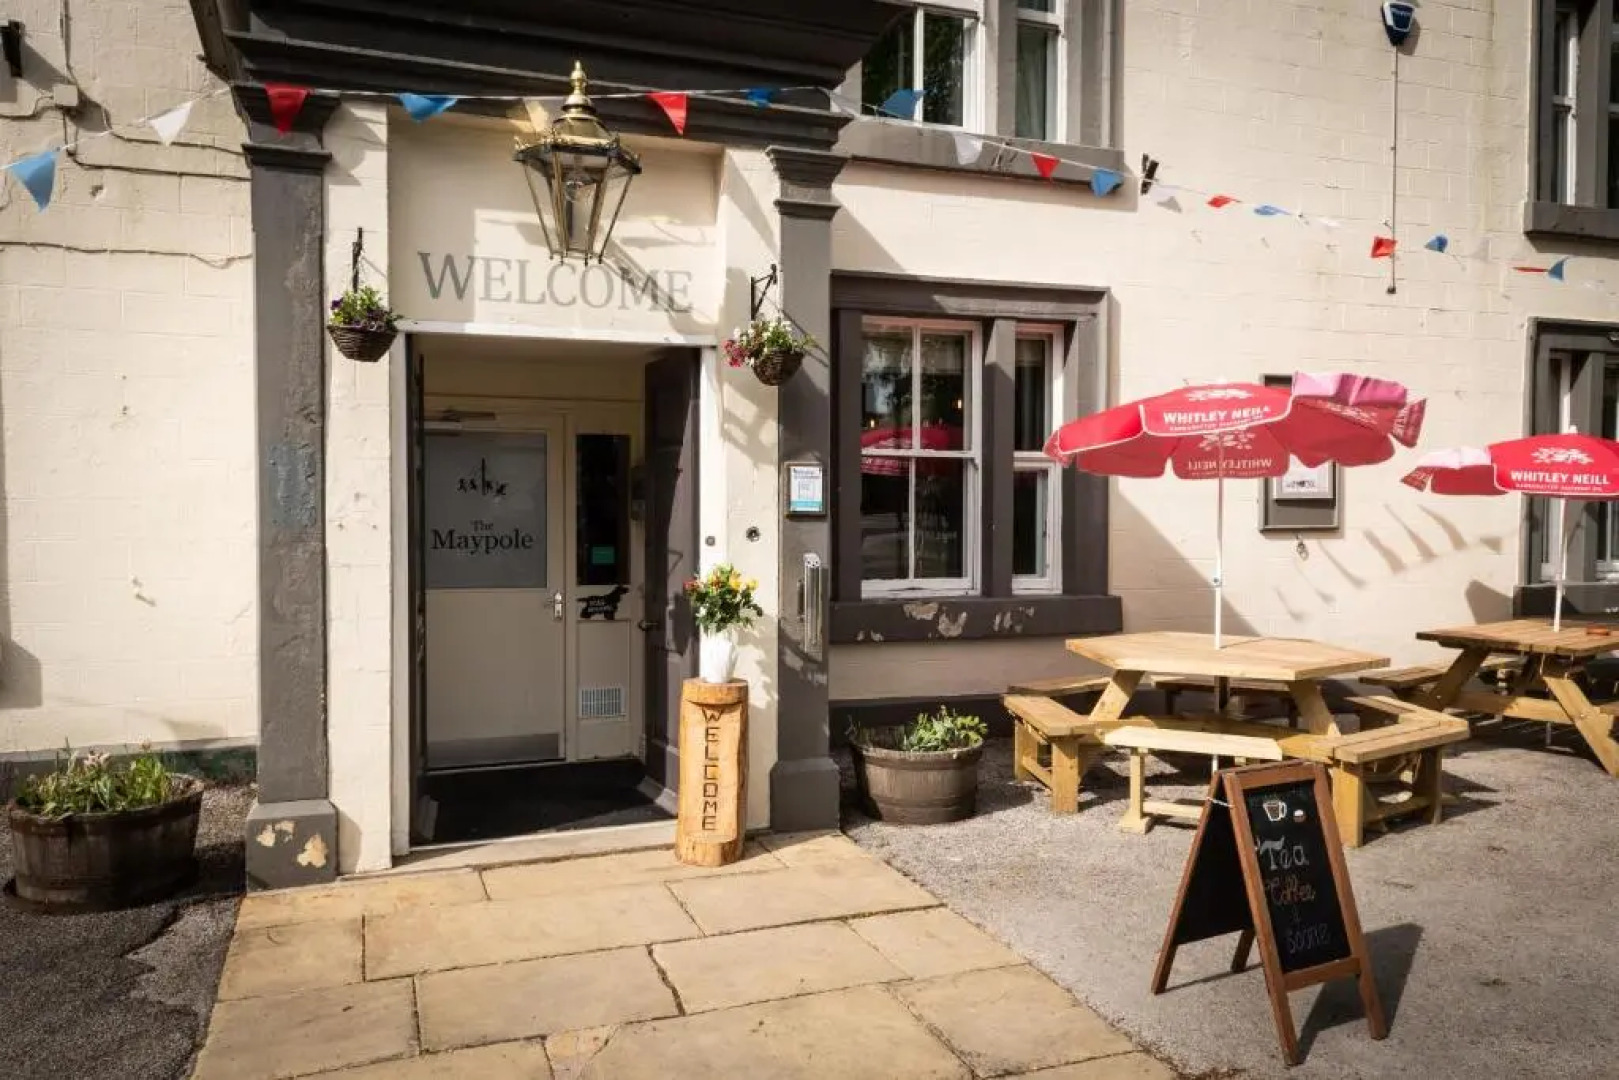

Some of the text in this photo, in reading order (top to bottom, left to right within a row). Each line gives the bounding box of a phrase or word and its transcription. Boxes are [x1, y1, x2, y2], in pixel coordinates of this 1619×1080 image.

[417, 252, 693, 314] WELCOME
[1163, 410, 1227, 424] WHITLEY
[1511, 470, 1610, 485] WHITLEY NEILL
[471, 519, 494, 531] The
[431, 528, 534, 554] Maypole
[702, 709, 723, 831] WELCOME
